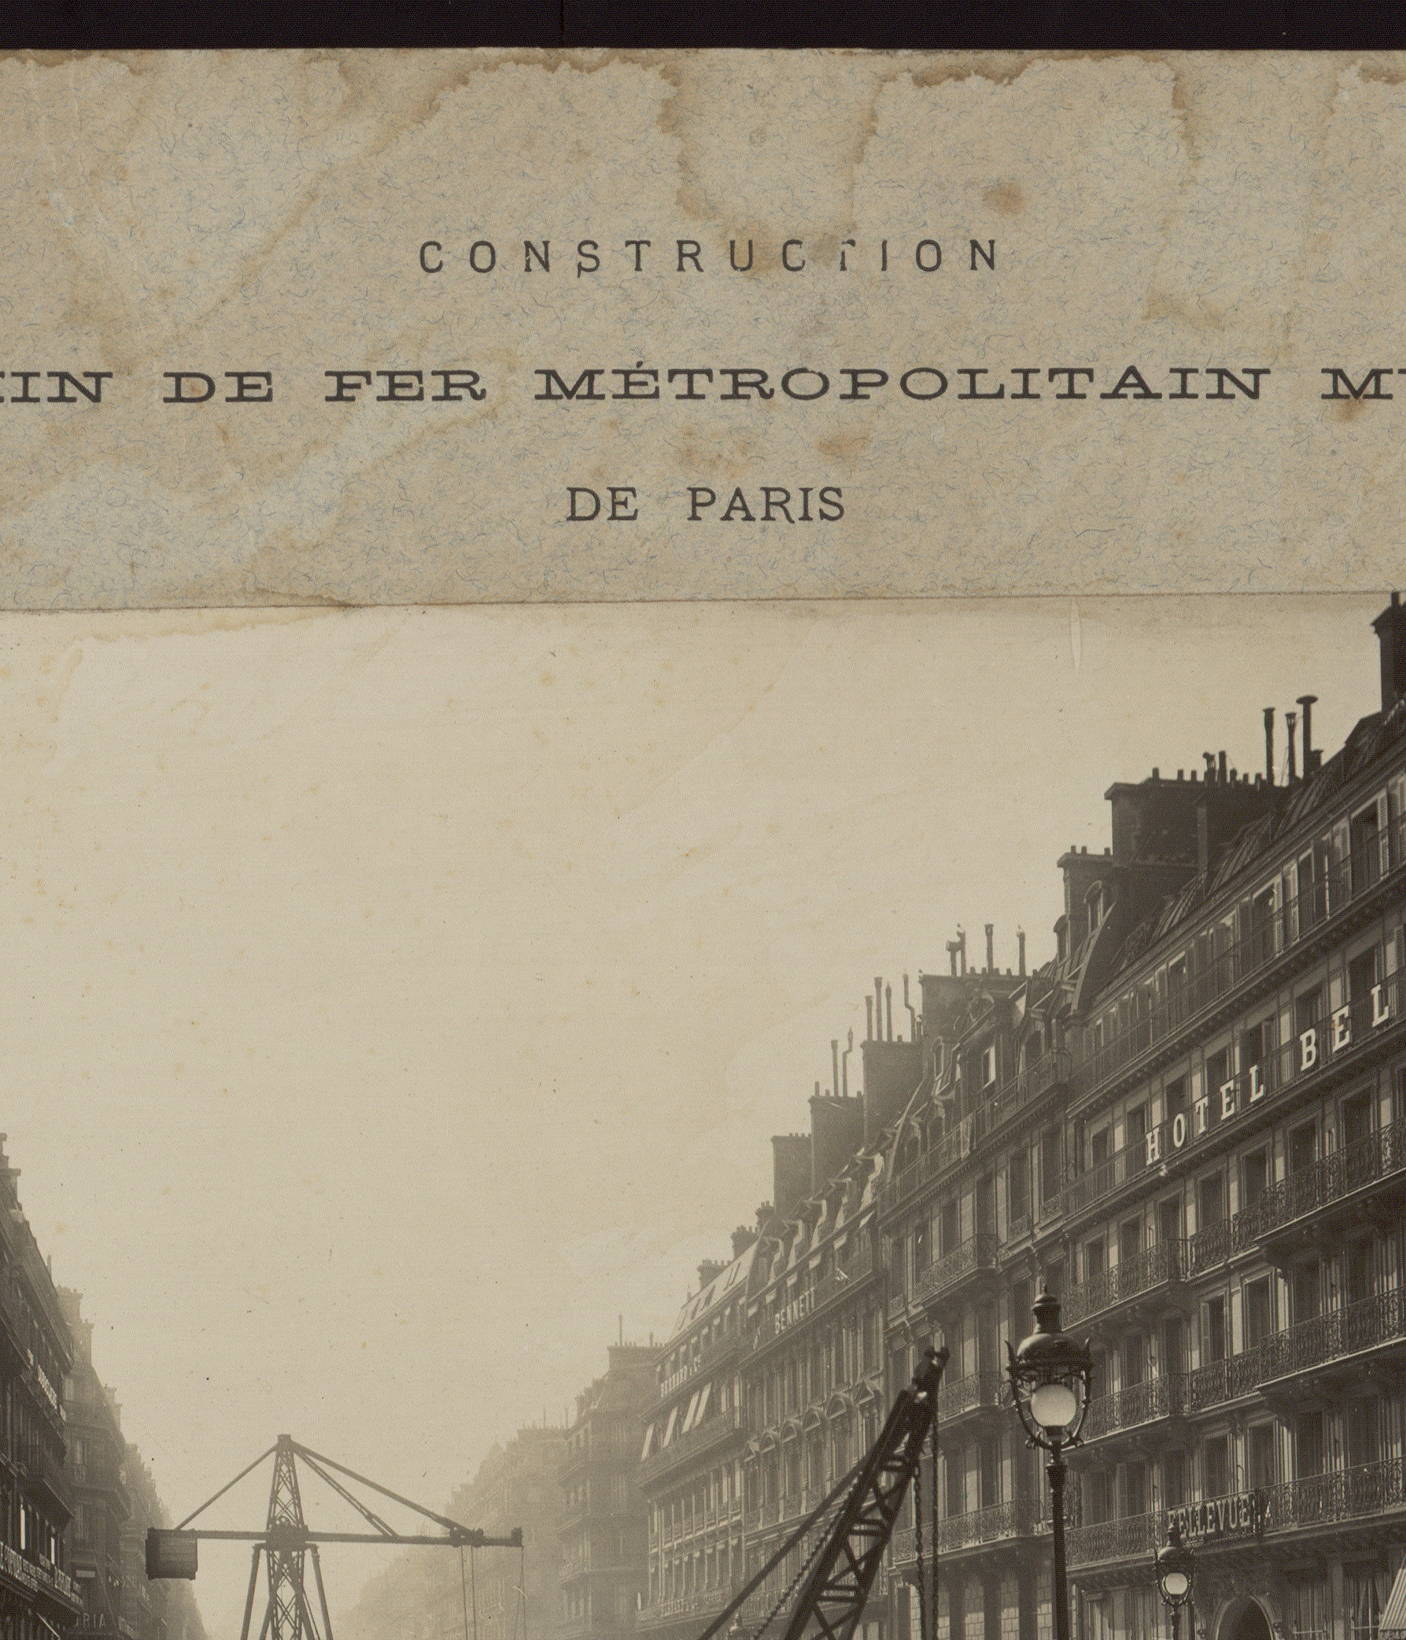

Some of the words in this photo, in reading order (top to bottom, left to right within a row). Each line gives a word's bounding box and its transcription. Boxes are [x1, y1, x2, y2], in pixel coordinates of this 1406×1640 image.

[419, 238, 997, 279] CONSTRUCTION
[162, 370, 274, 404] DE
[324, 369, 487, 404] FER
[533, 360, 1272, 403] MÉTROPOLITAIN
[565, 486, 639, 523] DE
[686, 486, 845, 525] PARIS
[1144, 1064, 1265, 1165] HOTEL
[1167, 1492, 1252, 1539] BELLEVUE
